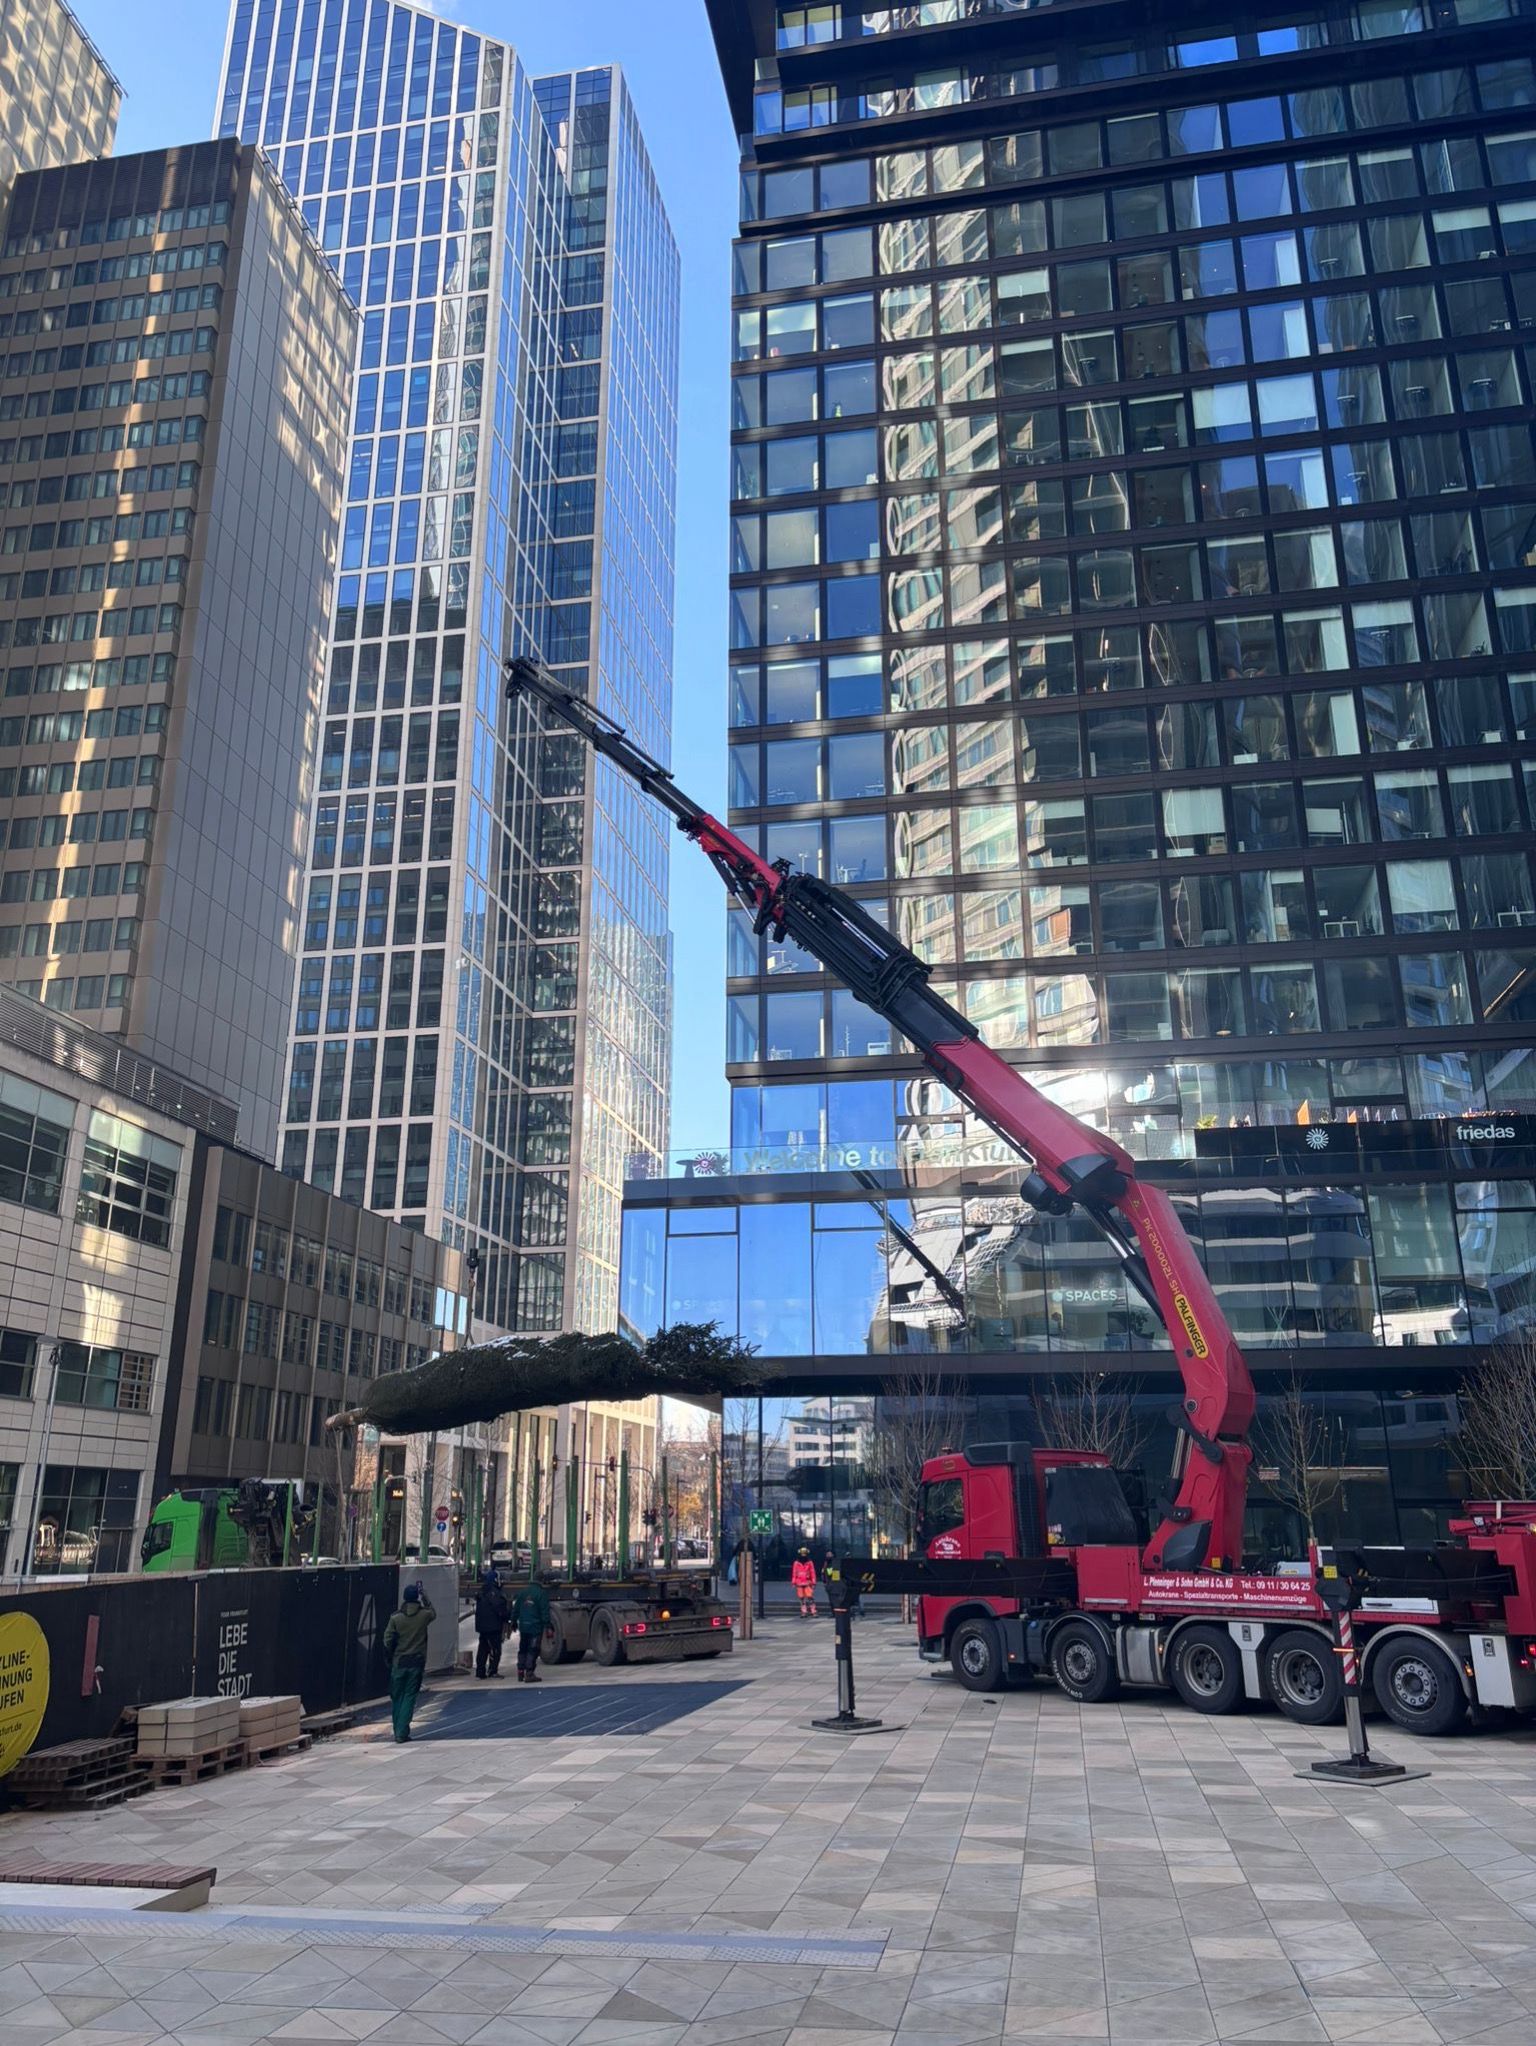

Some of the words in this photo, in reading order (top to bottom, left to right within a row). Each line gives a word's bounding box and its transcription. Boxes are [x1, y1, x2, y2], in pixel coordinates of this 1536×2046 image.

[1456, 1124, 1515, 1140] friedas
[868, 1145, 894, 1167] to
[1065, 1290, 1118, 1302] SPACES
[1175, 1296, 1207, 1356] PALFINGER
[1194, 1577, 1210, 1588] GmbH
[1225, 1578, 1234, 1589] KG
[1256, 1581, 1266, 1590] 09
[1267, 1581, 1275, 1590] 11
[1280, 1582, 1289, 1590] 30
[1290, 1582, 1300, 1591] 64
[1300, 1582, 1311, 1591] 25
[1148, 1590, 1179, 1599] Autokrane
[1183, 1591, 1238, 1601] Spezialtransporte
[1243, 1593, 1307, 1604] Maschinenumzüge
[219, 1622, 248, 1649] LEBE
[218, 1650, 238, 1676] DIE
[0, 1667, 33, 1690] NUNG
[217, 1673, 253, 1698] STADT
